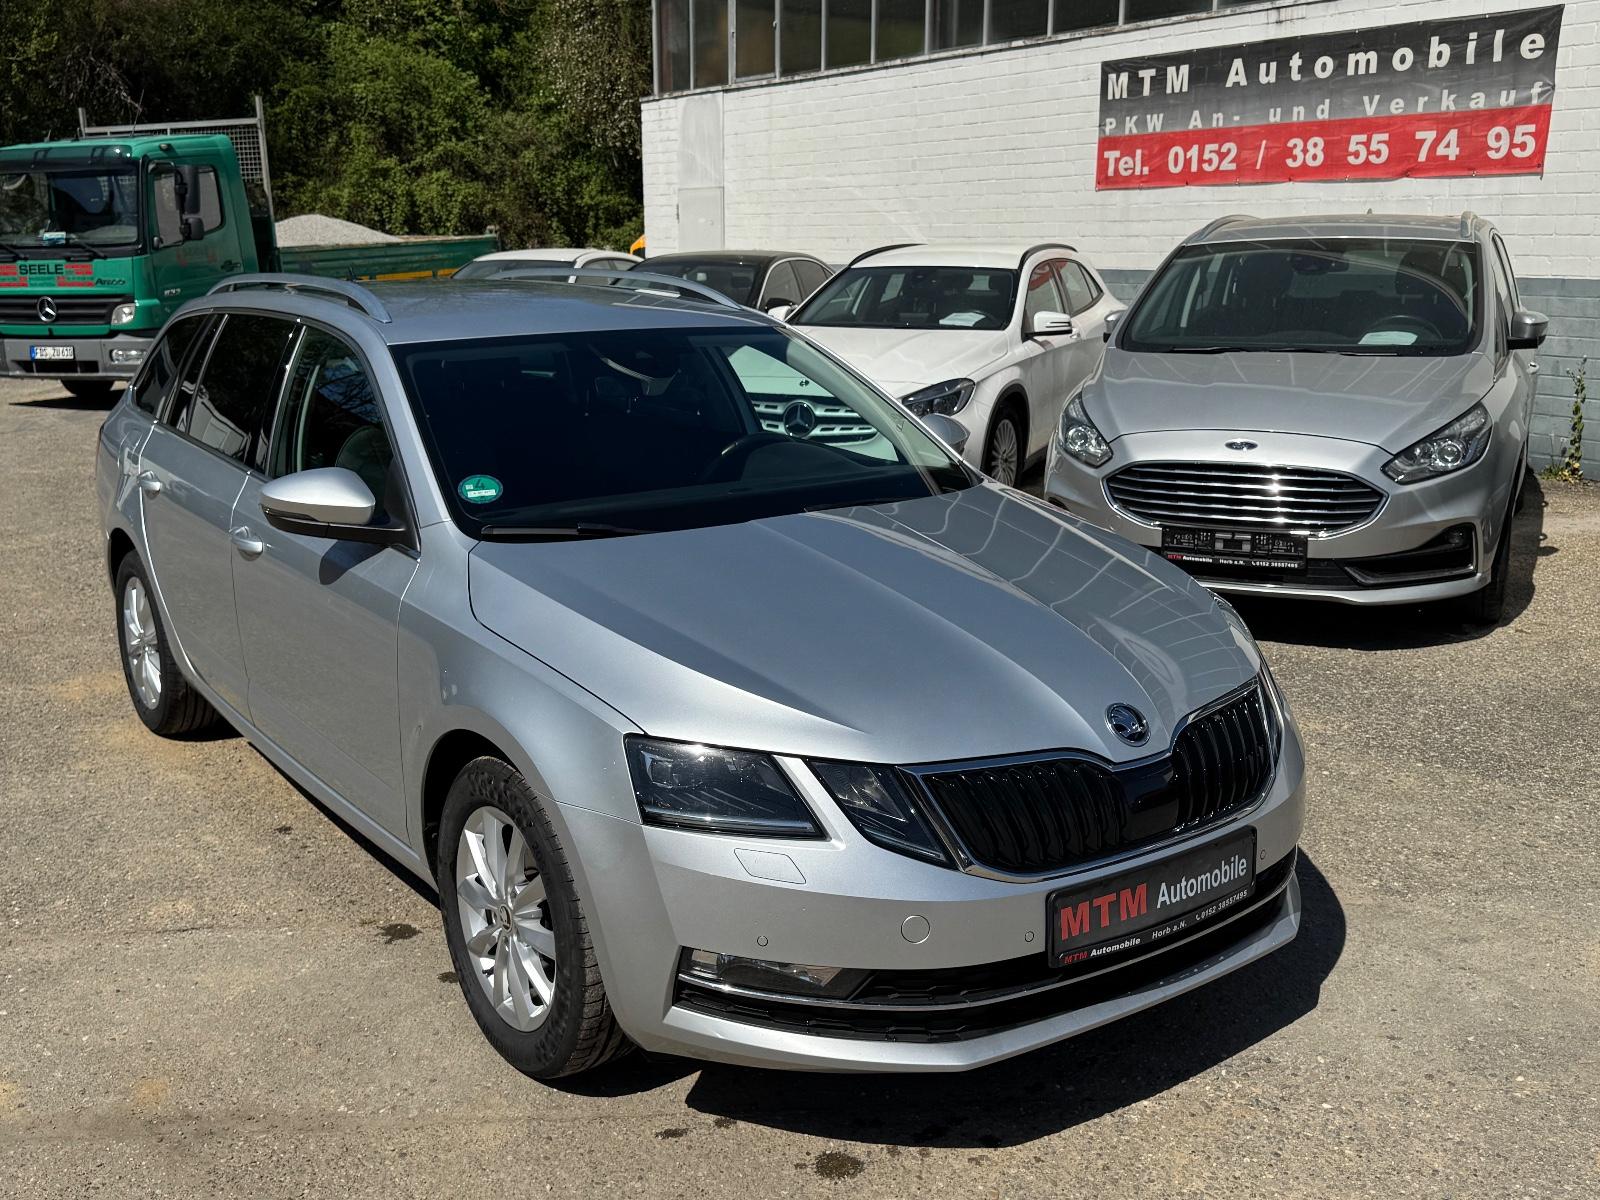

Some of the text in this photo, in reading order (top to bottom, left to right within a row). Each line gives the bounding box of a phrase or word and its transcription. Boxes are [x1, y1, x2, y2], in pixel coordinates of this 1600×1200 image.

[1107, 30, 1546, 100] MTM Automobile
[1105, 81, 1544, 136] PKW An- und Verkauf
[1104, 150, 1149, 177] Tel.
[1168, 142, 1237, 174] 0152
[1285, 137, 1325, 167] 38
[1347, 133, 1390, 165] 55
[1415, 129, 1460, 162] 74
[1486, 124, 1537, 159] 95
[19, 263, 64, 275] SEELE
[1060, 855, 1247, 941] MTM Automobile
[1063, 951, 1089, 965] MTM
[1090, 937, 1141, 958] Automobile
[1152, 926, 1171, 940] Horb
[1201, 905, 1216, 919] 0152
